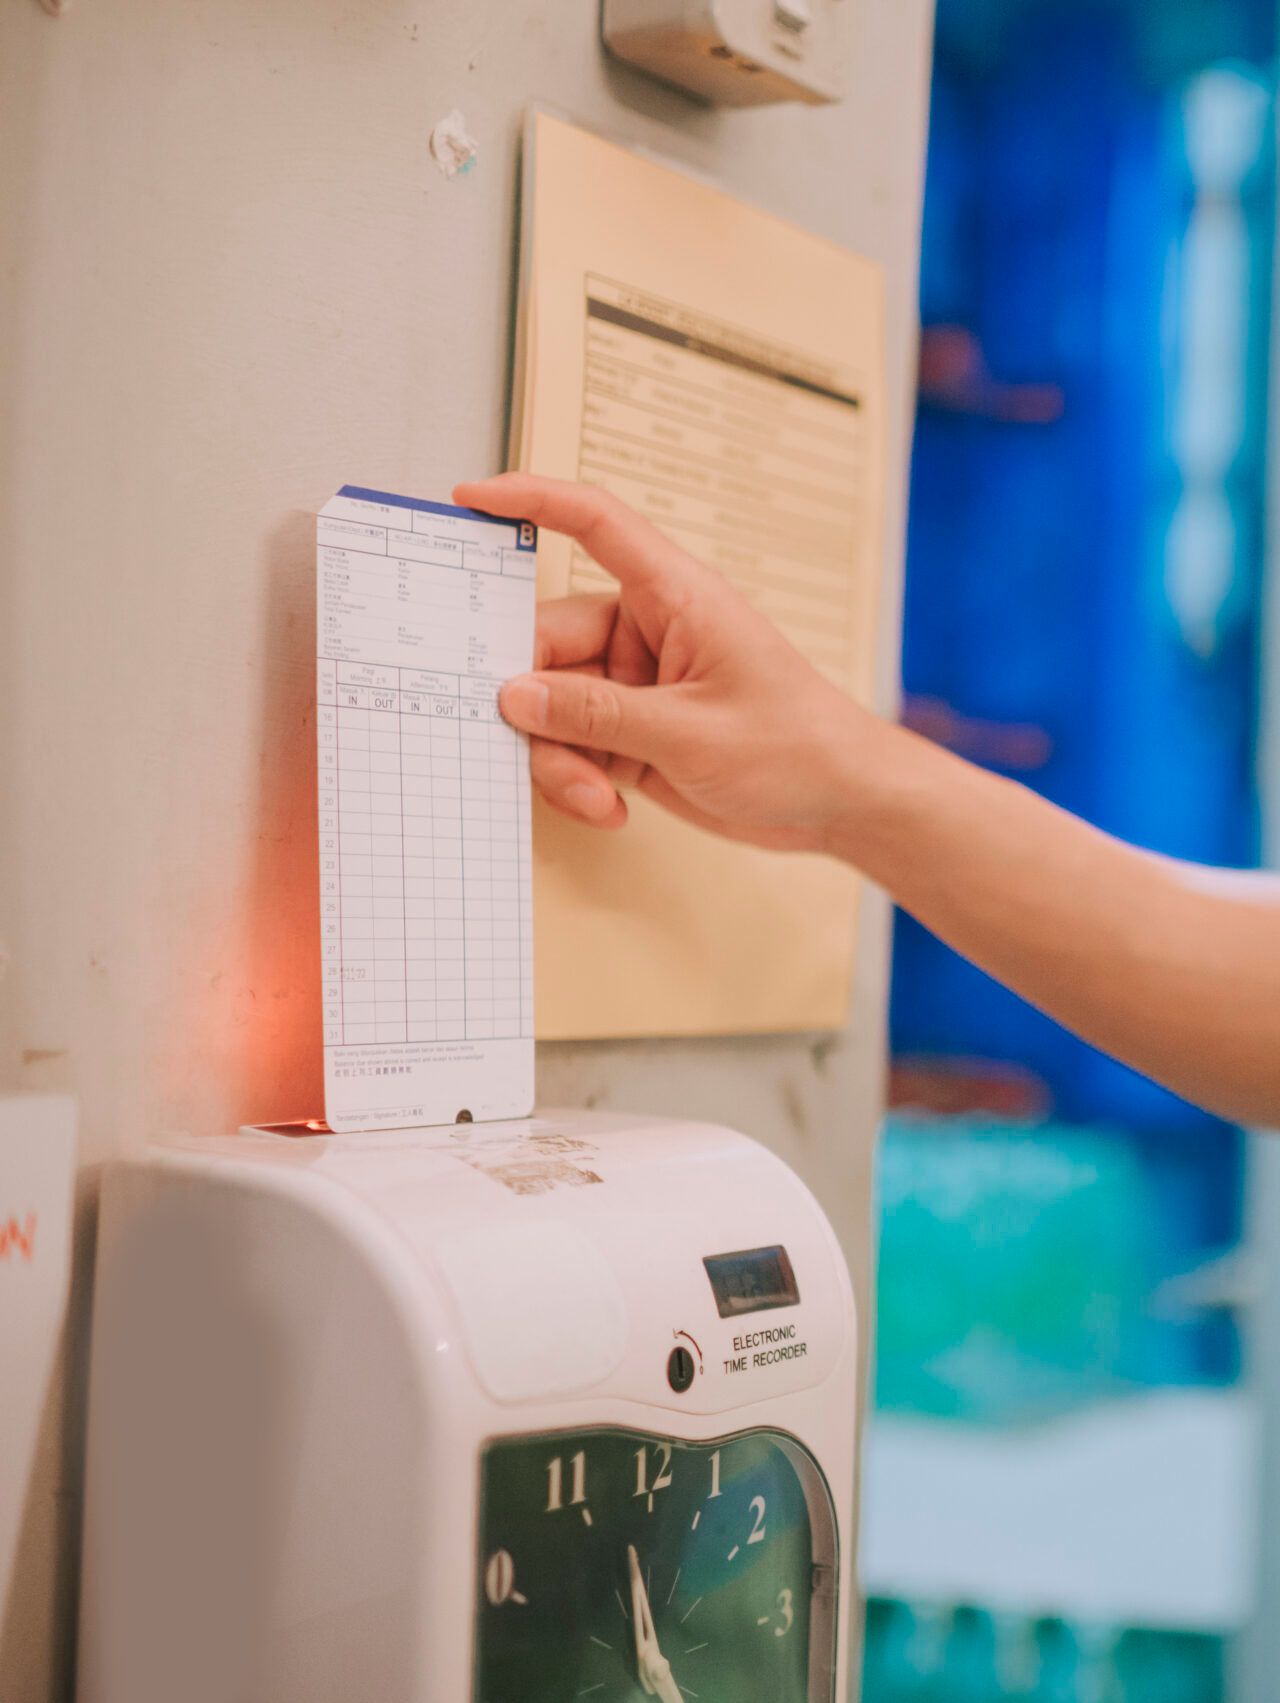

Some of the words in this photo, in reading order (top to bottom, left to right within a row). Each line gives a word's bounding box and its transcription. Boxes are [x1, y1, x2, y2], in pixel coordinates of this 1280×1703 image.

[520, 524, 534, 546] B
[348, 695, 358, 705] IN
[374, 697, 394, 709] OUT
[410, 702, 420, 712] IN
[435, 704, 453, 715] OUT
[470, 709, 479, 718] IN
[733, 1325, 796, 1351] ELECTRONIC
[723, 1357, 748, 1374] TIME
[753, 1343, 808, 1368] RECORDER
[545, 1450, 587, 1512] 11
[632, 1443, 673, 1497] 12
[707, 1450, 722, 1499] 1
[746, 1495, 766, 1545] 2
[774, 1589, 793, 1637] 3
